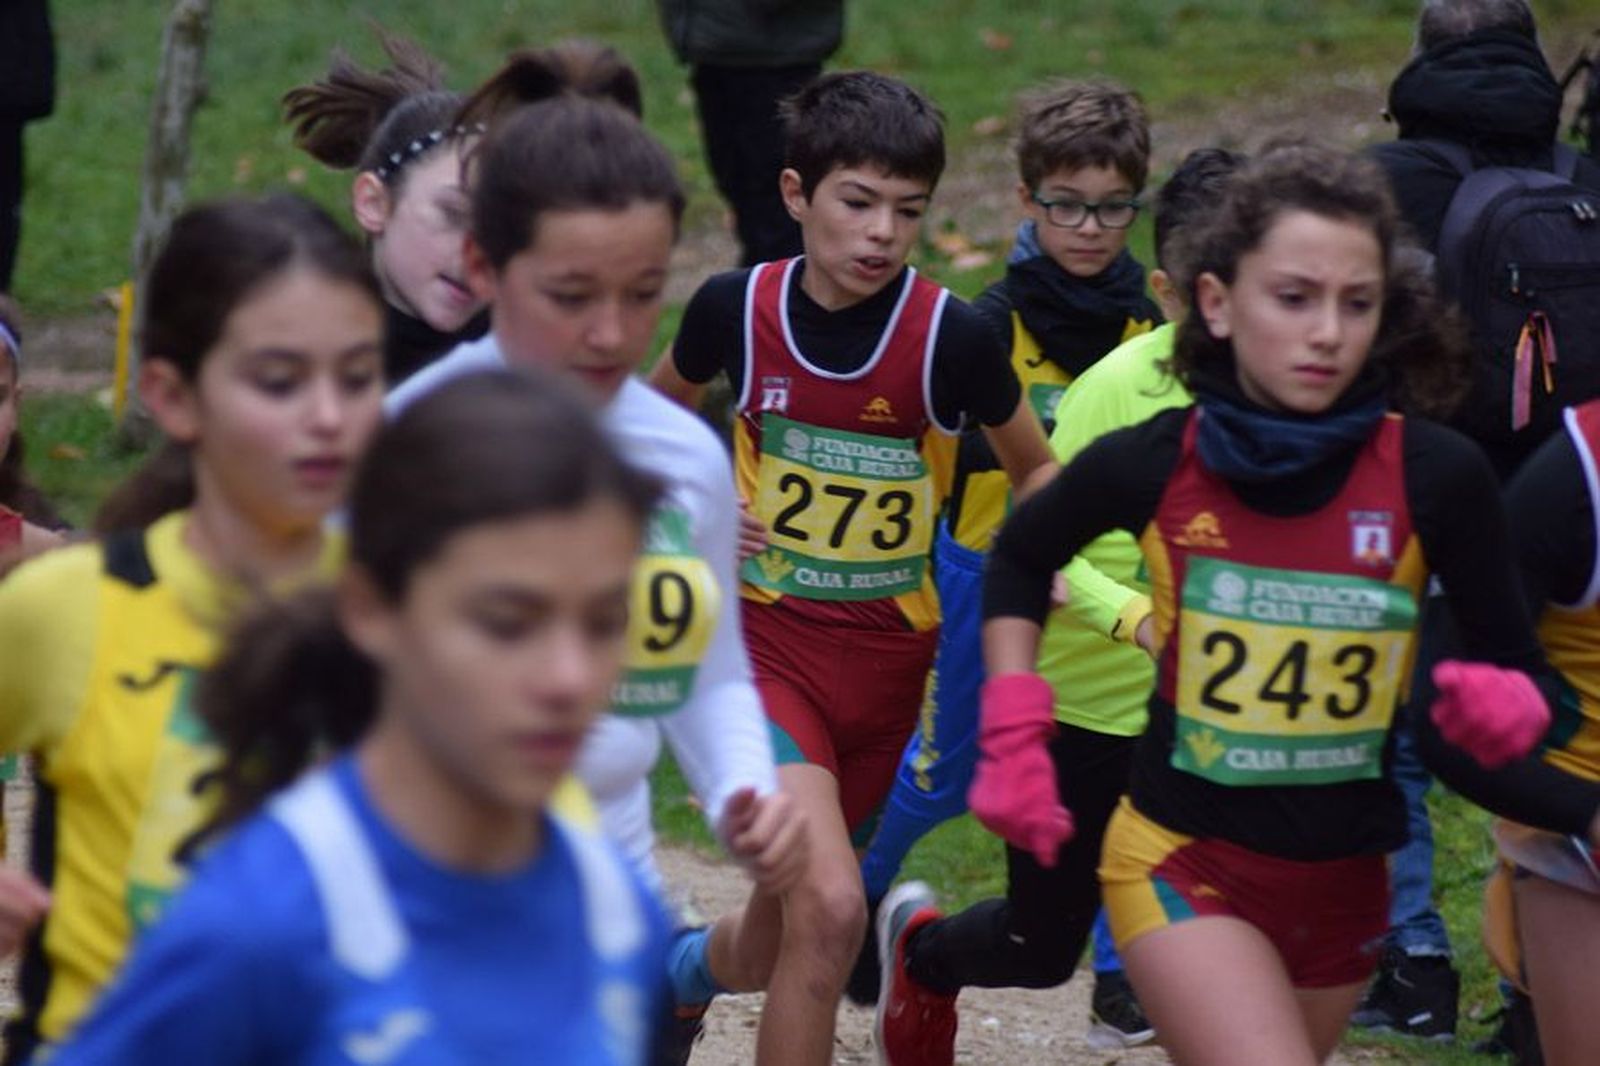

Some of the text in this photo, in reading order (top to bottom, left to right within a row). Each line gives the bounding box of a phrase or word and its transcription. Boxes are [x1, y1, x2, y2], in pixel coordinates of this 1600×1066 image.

[773, 472, 914, 550] 273
[794, 567, 915, 589] CAJA RURAL
[1199, 631, 1377, 720] 243
[1225, 746, 1288, 771] CAJA
